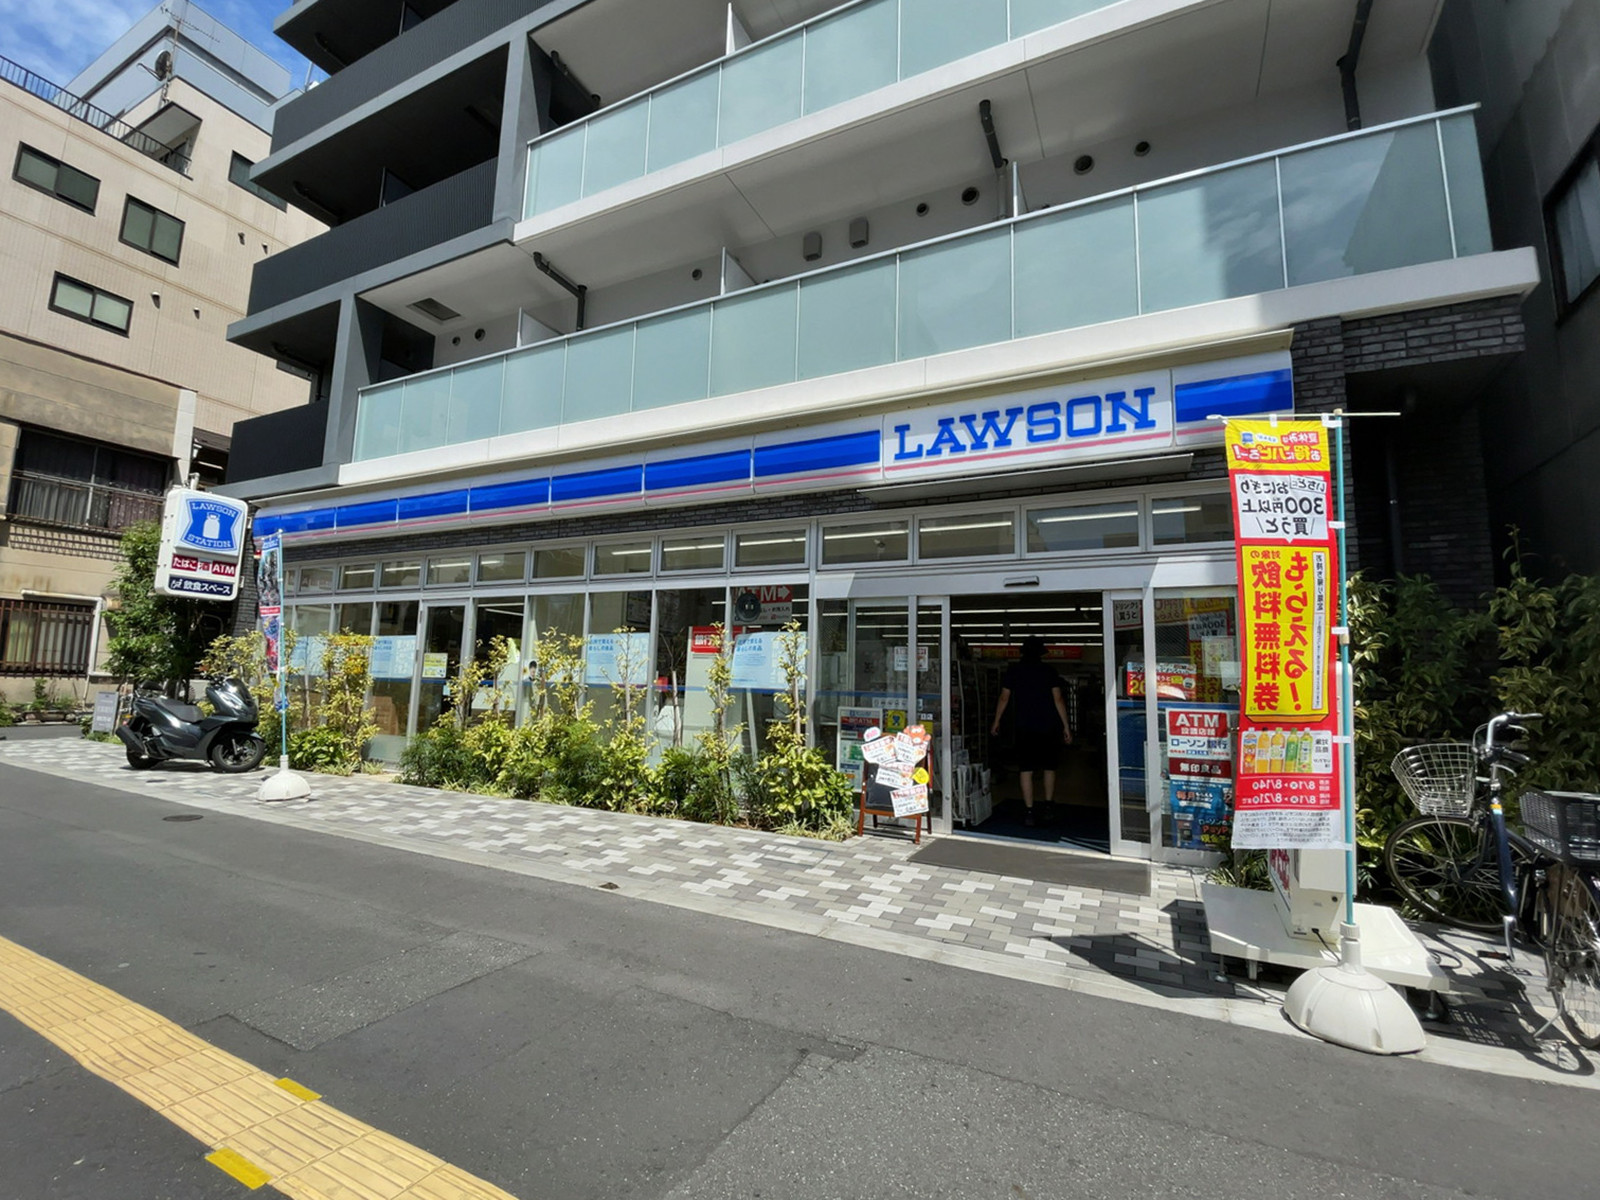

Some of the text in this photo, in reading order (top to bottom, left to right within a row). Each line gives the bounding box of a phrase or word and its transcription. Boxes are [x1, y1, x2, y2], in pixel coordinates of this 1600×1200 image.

[894, 387, 1156, 460] LAWSON
[191, 502, 236, 517] LAWSON
[187, 533, 231, 548] STATION
[173, 556, 197, 570] たばこ
[212, 563, 235, 575] ATM
[183, 580, 231, 595] 飲食スペース
[1176, 714, 1219, 728] ATM
[1171, 738, 1228, 749] ローソン銀行
[1180, 762, 1222, 774] 無印良品
